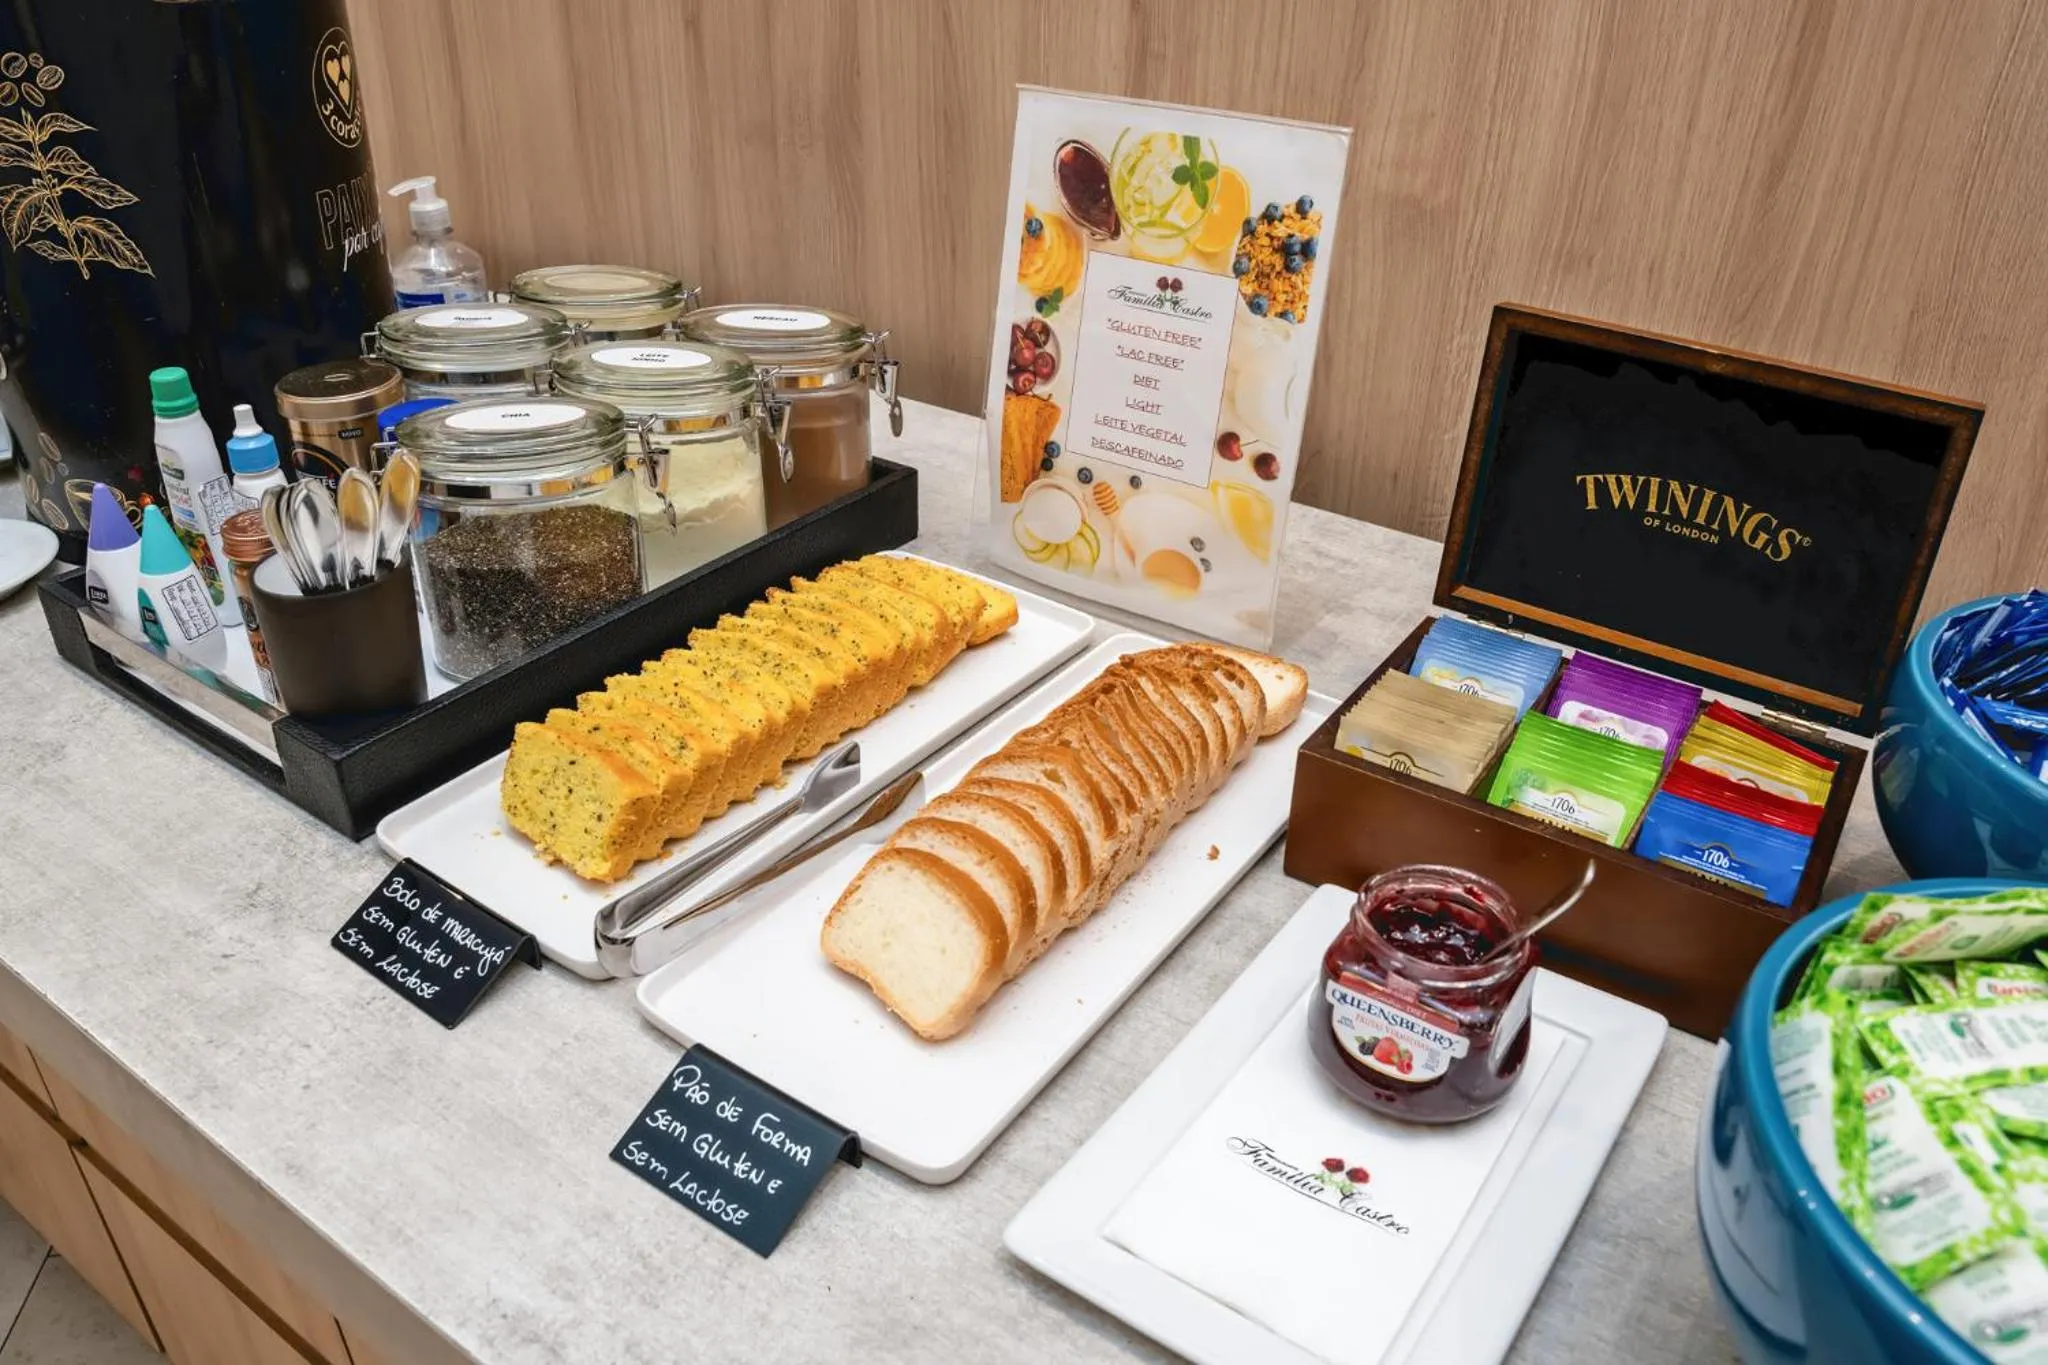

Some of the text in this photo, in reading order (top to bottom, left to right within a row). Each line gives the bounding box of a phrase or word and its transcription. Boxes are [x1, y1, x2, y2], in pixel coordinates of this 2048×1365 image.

[1133, 373, 1161, 390] DIET
[1125, 396, 1163, 415] LIGHT
[1094, 413, 1188, 447] LEITE VEGETAL
[1091, 436, 1185, 470] DESCAFEINADO
[1576, 474, 1802, 563] TWININGS
[1643, 516, 1719, 545] OF LONDON
[1551, 796, 1575, 815] 1706
[1702, 848, 1730, 869] 1706
[382, 876, 420, 911] Bolo
[1331, 987, 1455, 1051] QUEENSBERRY
[1339, 1186, 1409, 1236] Castro
